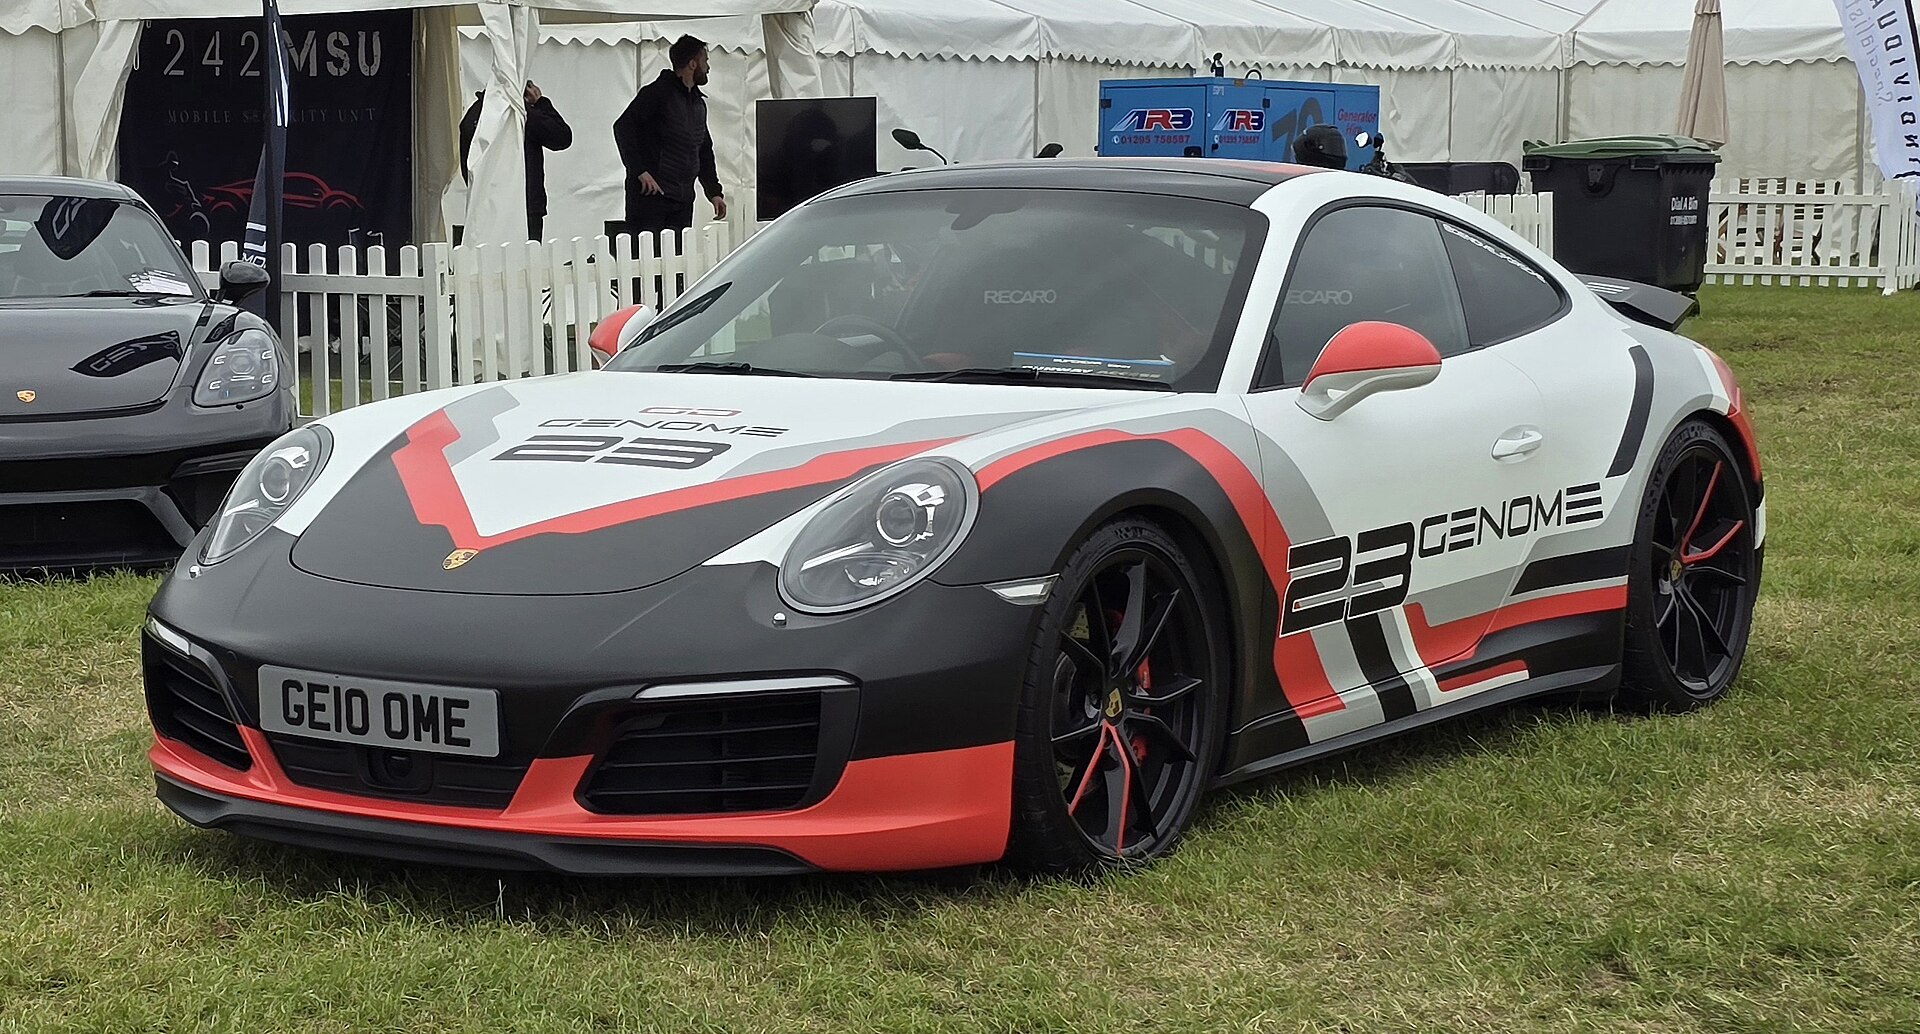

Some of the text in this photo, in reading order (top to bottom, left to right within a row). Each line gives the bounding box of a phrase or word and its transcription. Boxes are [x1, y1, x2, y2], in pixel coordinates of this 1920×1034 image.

[163, 29, 382, 77] 242 MSU
[168, 109, 231, 124] MOBILE
[242, 109, 328, 123] SEITY
[1110, 107, 1195, 132] ARB
[1212, 108, 1265, 133] ARB
[1338, 109, 1377, 123] Generator
[1671, 196, 1683, 211] Dial
[984, 289, 1057, 304] RECARO
[1284, 289, 1353, 305] ECARO
[537, 418, 790, 438] GENOME
[490, 434, 732, 470] 23
[1280, 483, 1603, 636] 23 GENOME
[281, 679, 471, 748] GE10 OME
